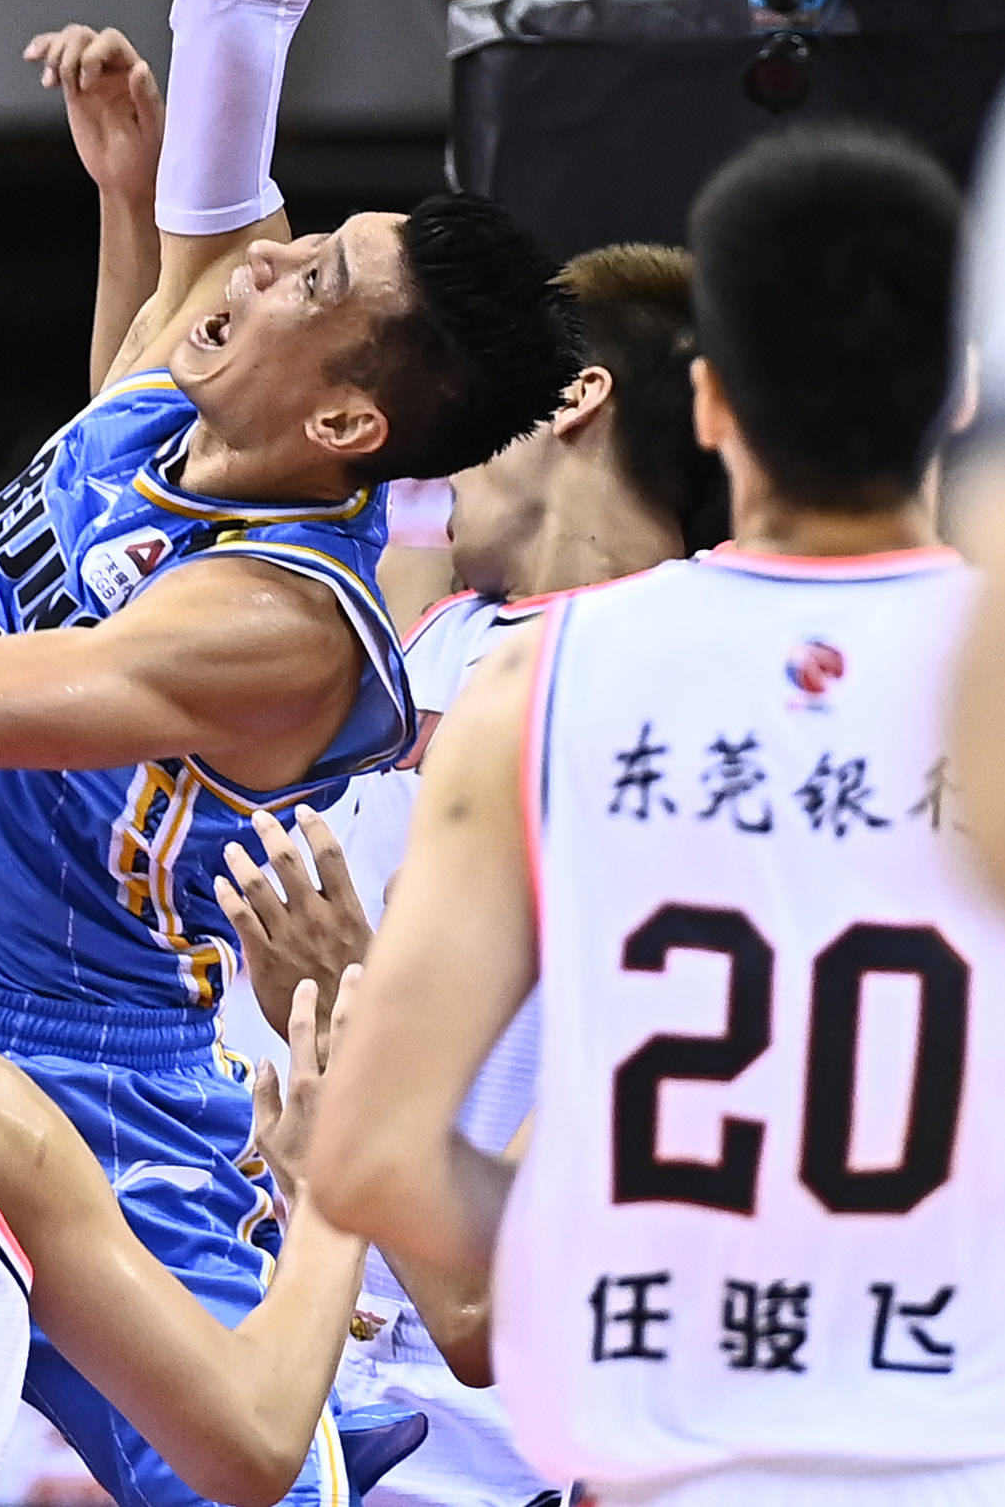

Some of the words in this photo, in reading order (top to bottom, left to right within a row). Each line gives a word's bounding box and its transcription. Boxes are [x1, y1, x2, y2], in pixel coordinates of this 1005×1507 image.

[611, 901, 971, 1216] 20
[589, 1269, 958, 1374] 任骏飞
